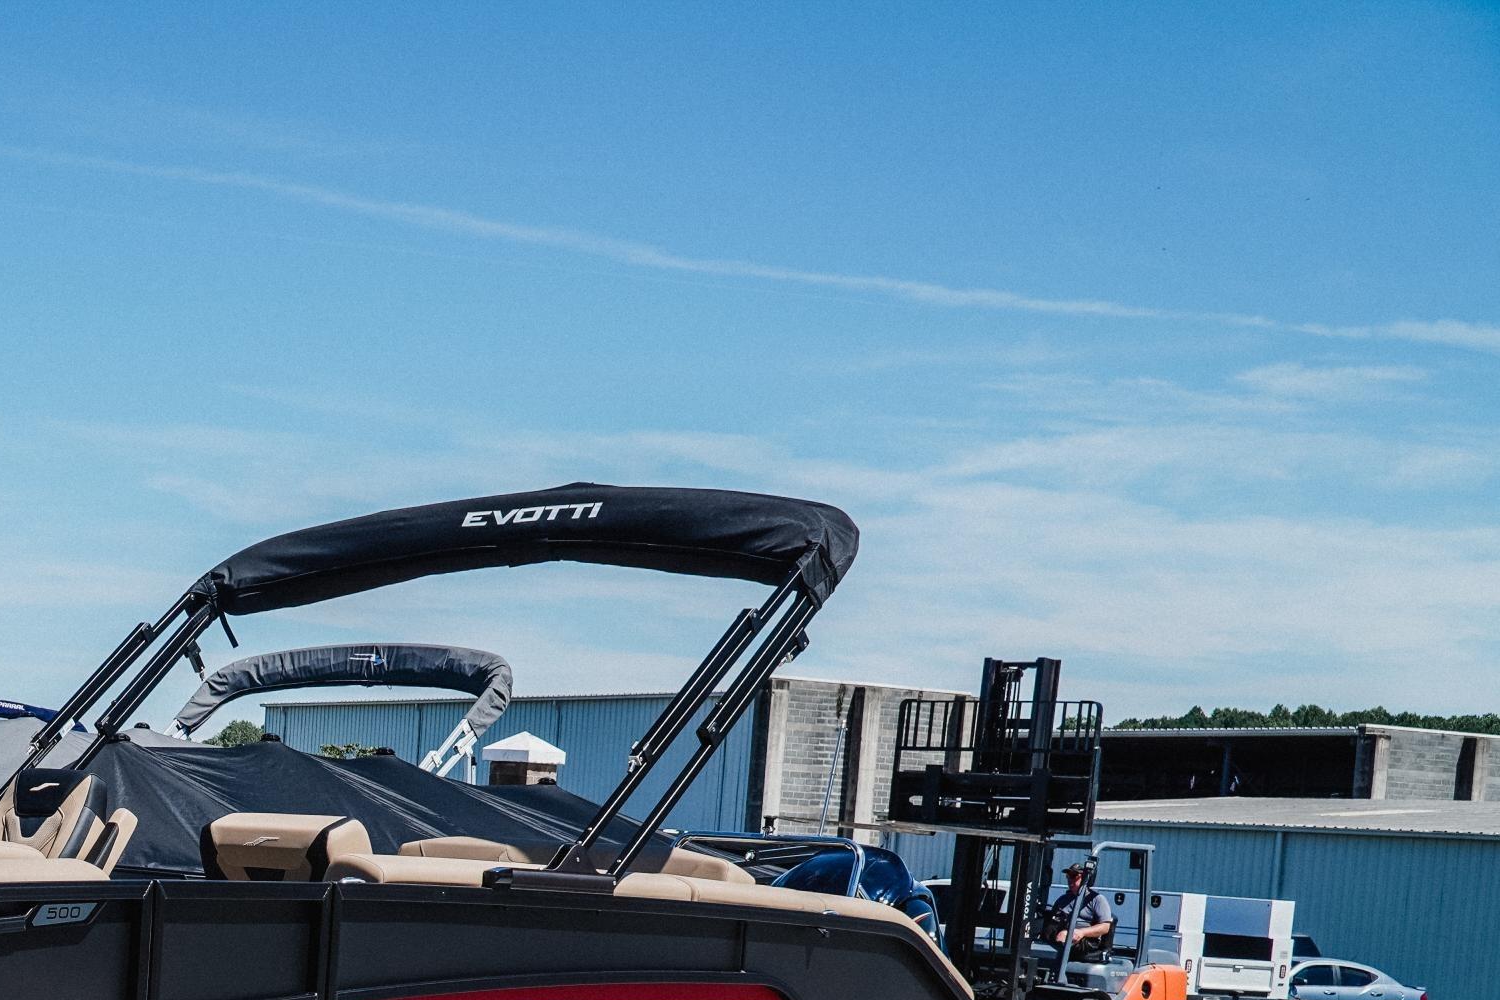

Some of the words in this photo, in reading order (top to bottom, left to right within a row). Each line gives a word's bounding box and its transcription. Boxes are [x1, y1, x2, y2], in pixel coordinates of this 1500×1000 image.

[461, 502, 604, 527] EVOTTI
[46, 906, 81, 919] 500
[1023, 881, 1032, 920] TOYOTA
